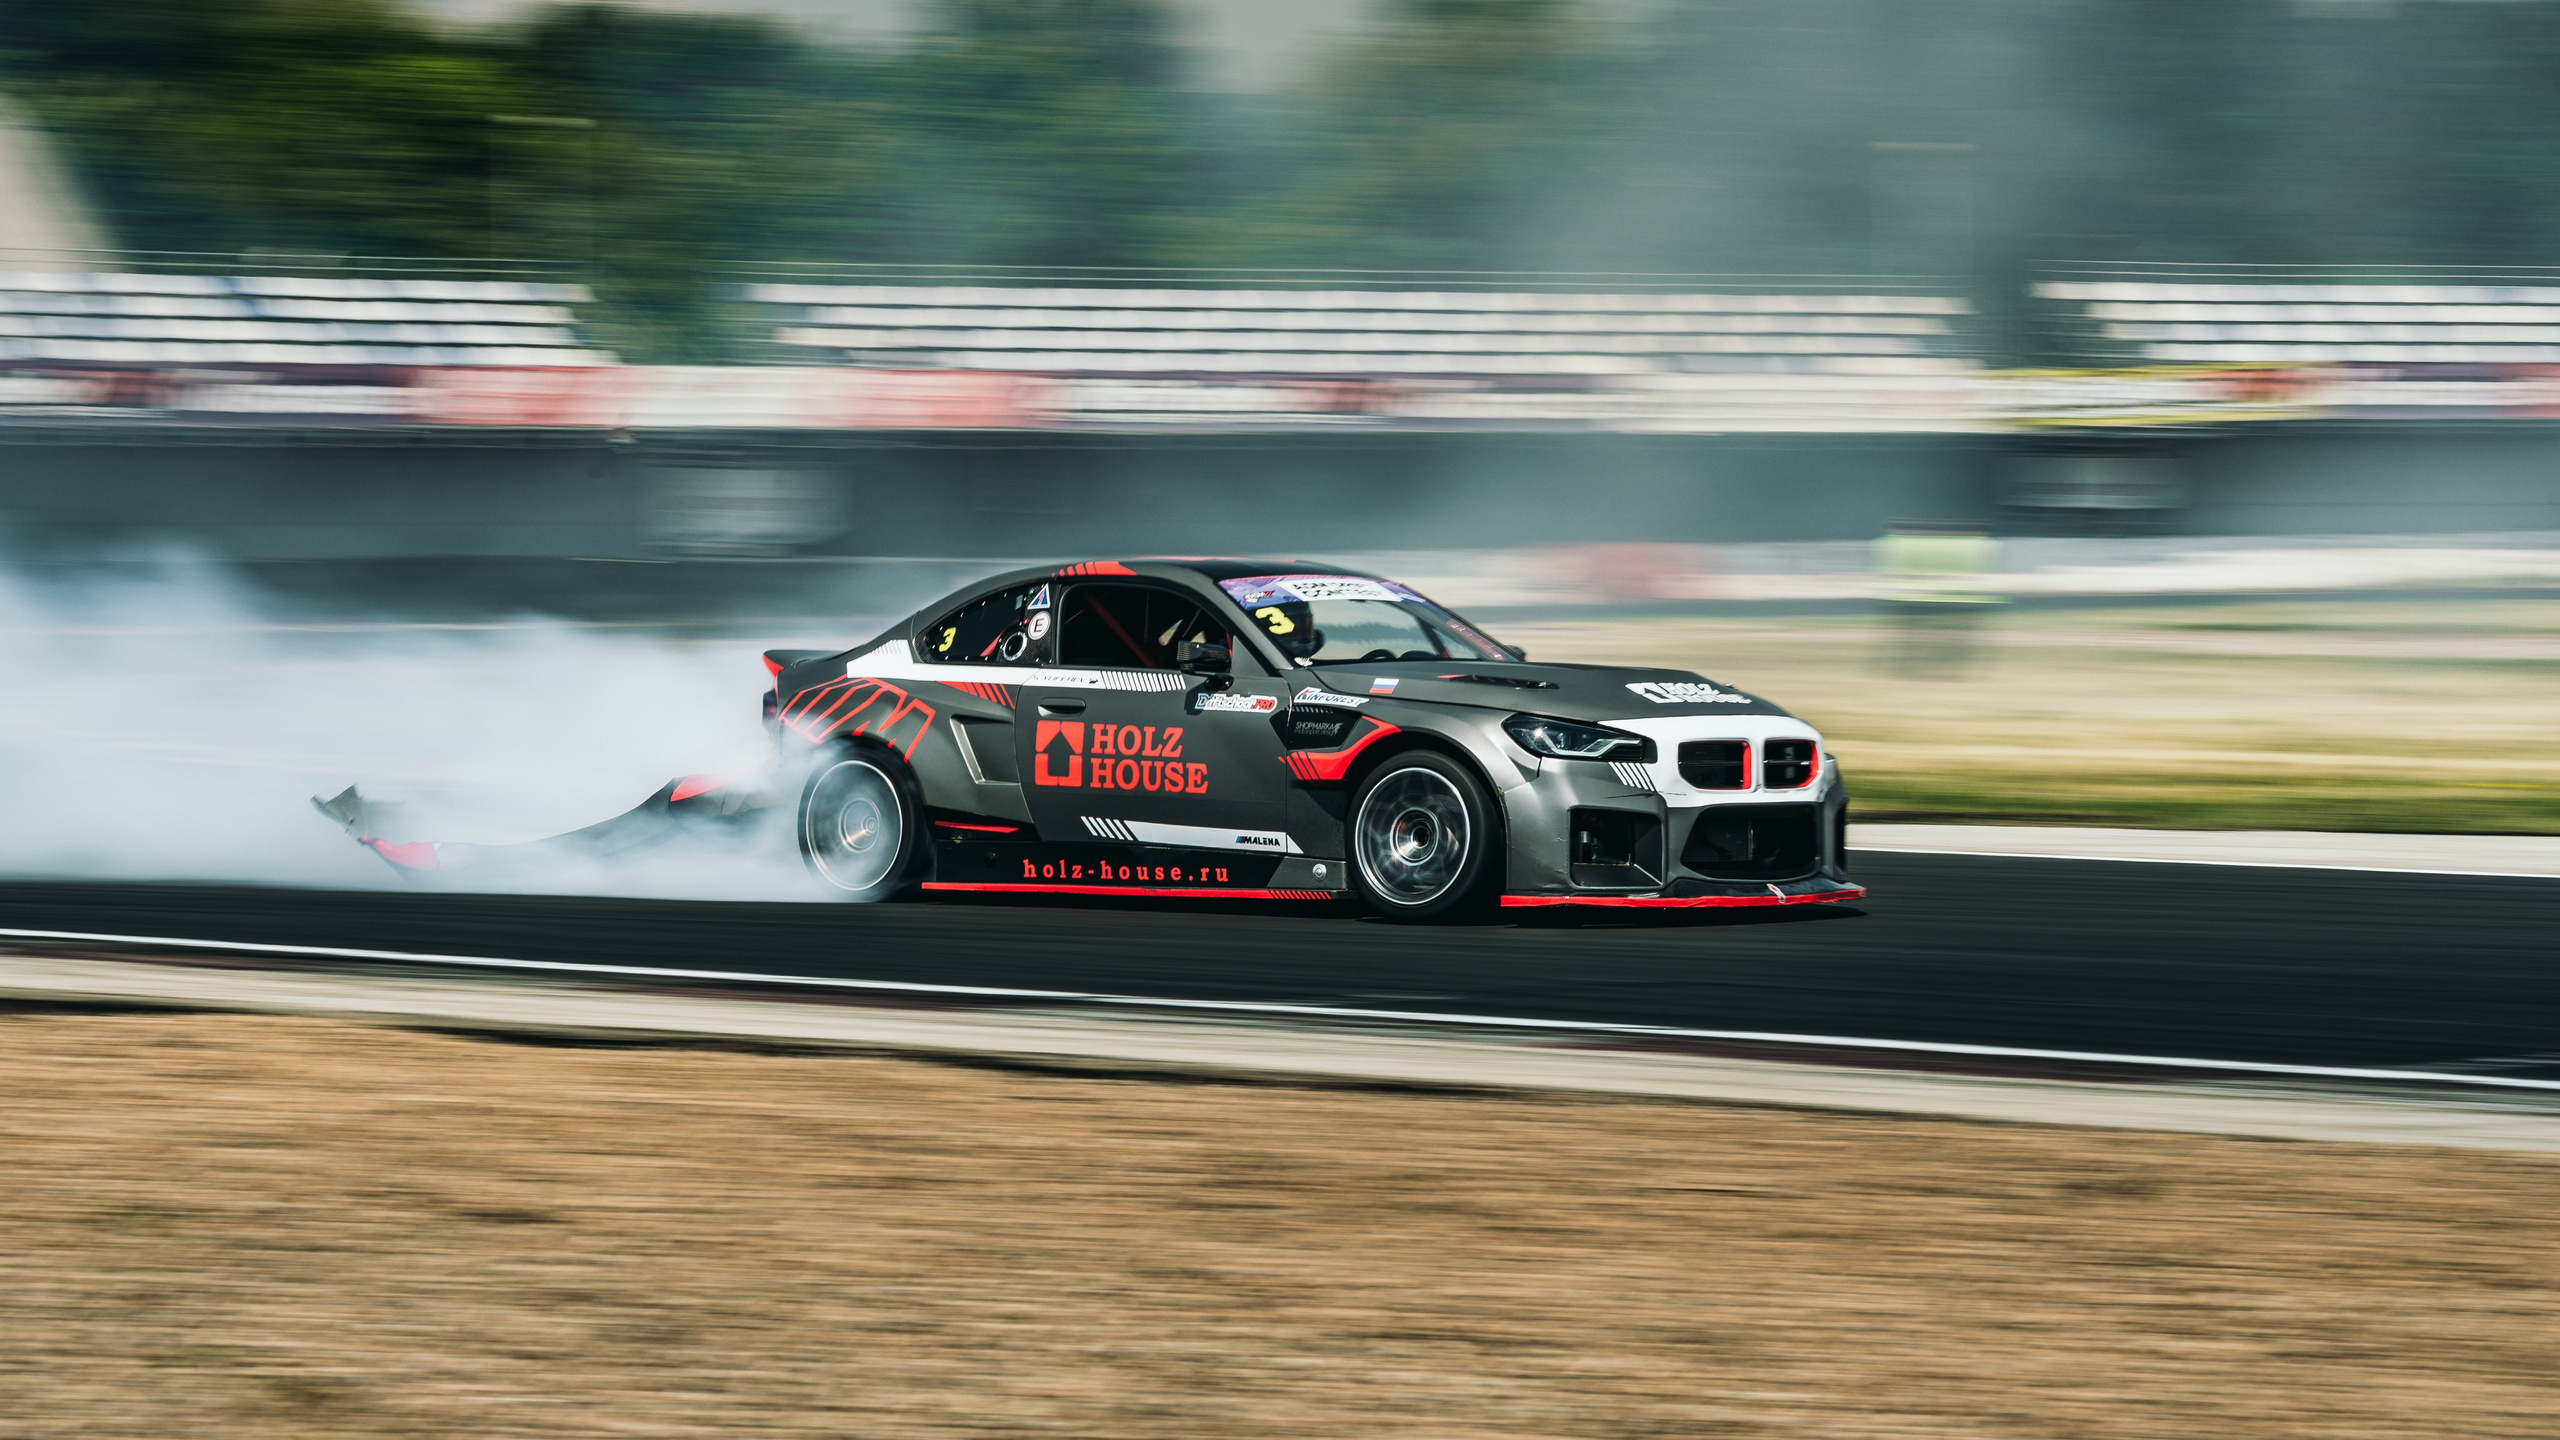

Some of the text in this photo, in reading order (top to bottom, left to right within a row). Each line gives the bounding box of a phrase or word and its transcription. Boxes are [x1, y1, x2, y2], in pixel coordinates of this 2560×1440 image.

[1034, 618, 1045, 633] E
[1254, 606, 1295, 635] 3
[938, 626, 957, 652] 3
[1297, 689, 1361, 705] KINFOREST
[1295, 721, 1334, 731] SHOPMARKA
[1091, 723, 1184, 758] HOLZ
[1089, 758, 1209, 794] HOUSE
[1023, 858, 1229, 882] holz-house.ru
